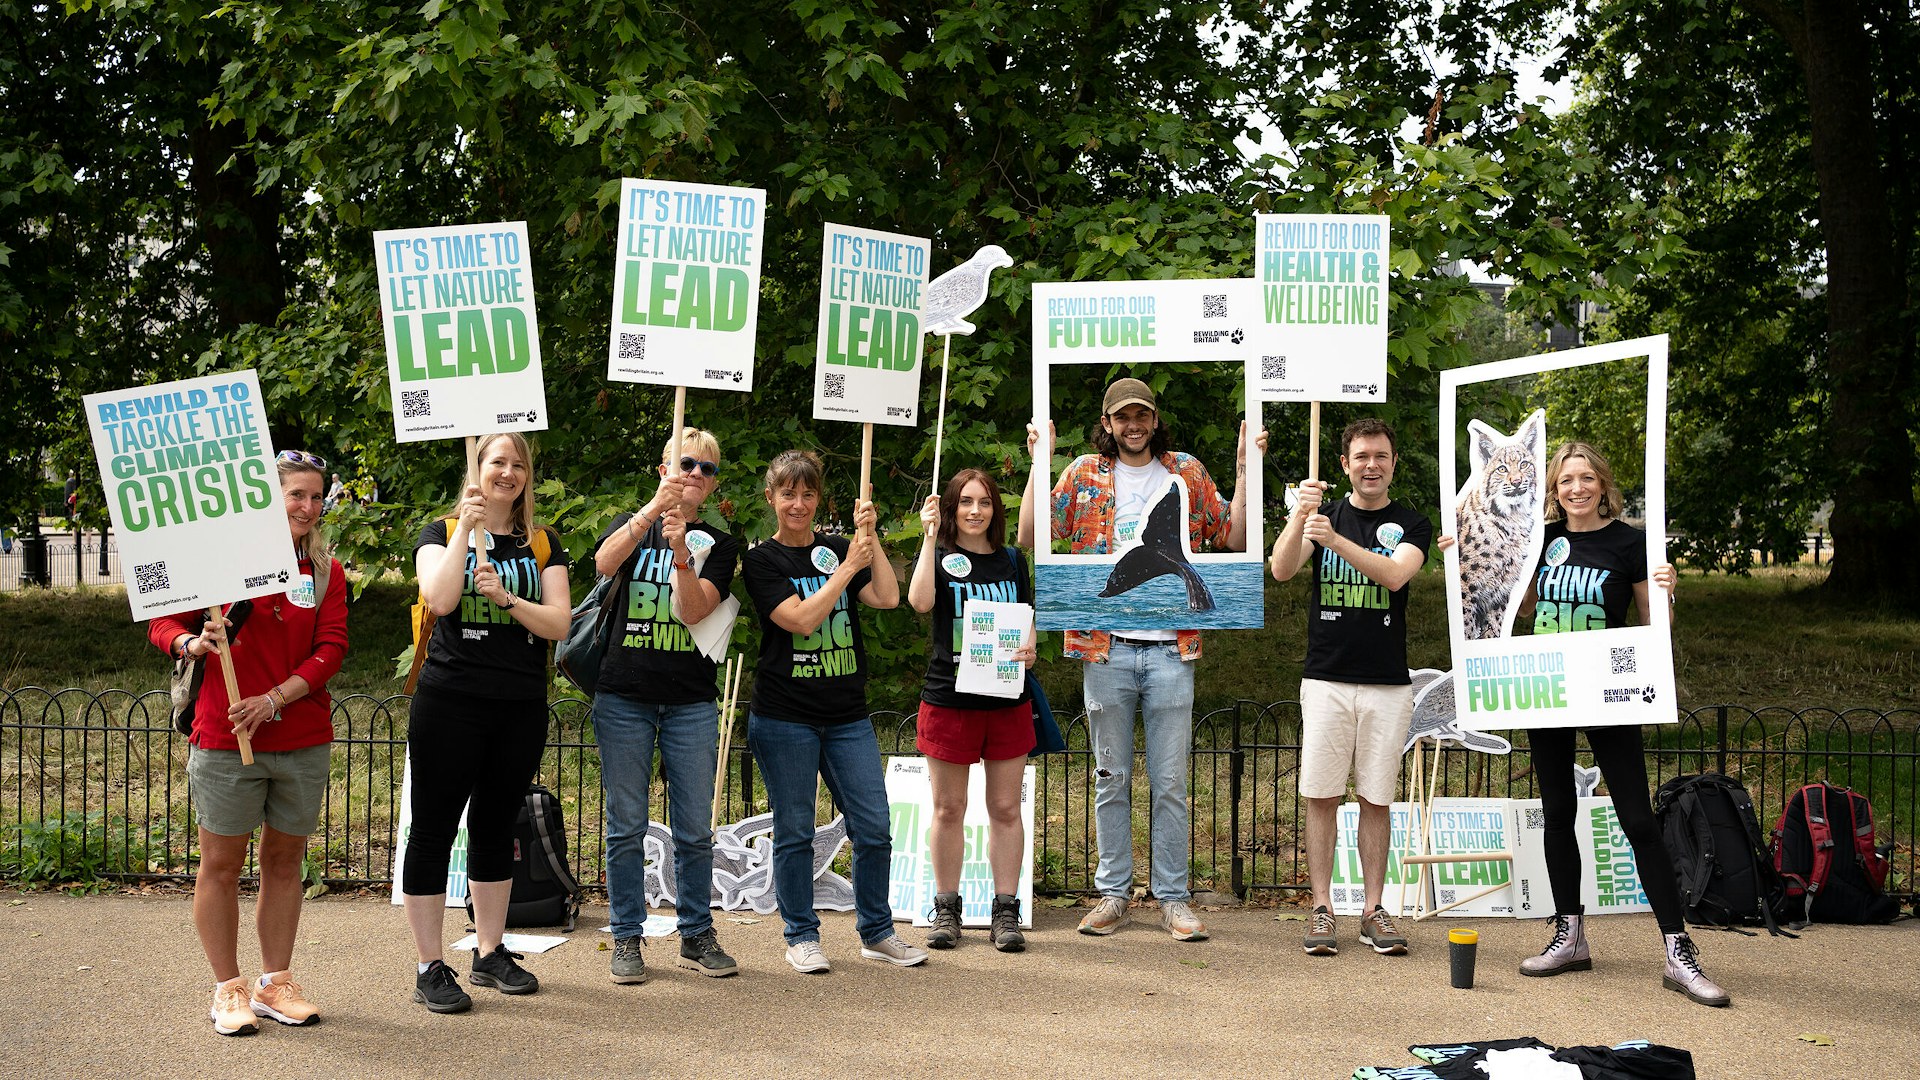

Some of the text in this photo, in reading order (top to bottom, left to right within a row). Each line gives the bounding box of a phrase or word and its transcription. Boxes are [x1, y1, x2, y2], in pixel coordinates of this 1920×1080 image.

[629, 188, 755, 229] IT'S TIME TO
[385, 231, 520, 273] IT'S TIME TO
[626, 223, 753, 266] LET NATURE
[832, 233, 924, 276] IT'S TIME TO
[1264, 222, 1381, 250] REWILD FOR OUR
[1264, 251, 1380, 283] HEALTH &
[389, 268, 524, 311] LET NATURE
[622, 260, 749, 332] LEAD
[830, 267, 923, 310] LET NATURE
[1048, 296, 1156, 316] REWILD FOR OUR
[1264, 284, 1379, 325] WELLBEING
[393, 307, 530, 382] LEAD
[826, 303, 919, 372] LEAD
[1048, 316, 1156, 348] FUTURE
[97, 382, 249, 424] REWILD TO
[102, 402, 258, 455] TACKLE THE
[110, 433, 263, 480] CLIMATE
[117, 459, 272, 532] CRISIS
[946, 560, 966, 570] VOTE
[1536, 565, 1611, 605] THINK
[628, 581, 683, 624] BI
[1320, 583, 1390, 610] REWILD
[622, 622, 696, 652] ACT WIL
[1534, 601, 1606, 634] BIG
[792, 648, 857, 678] ACT WILD
[1466, 652, 1564, 678] REWILD FOR OUR
[1468, 674, 1567, 712] FUTURE
[1433, 812, 1502, 829] IT'S TIME TO
[1435, 831, 1505, 849] LET NATURE
[1348, 850, 1419, 884] LAD
[1436, 850, 1509, 886] LEAD
[1590, 806, 1615, 906] WILDLIFE
